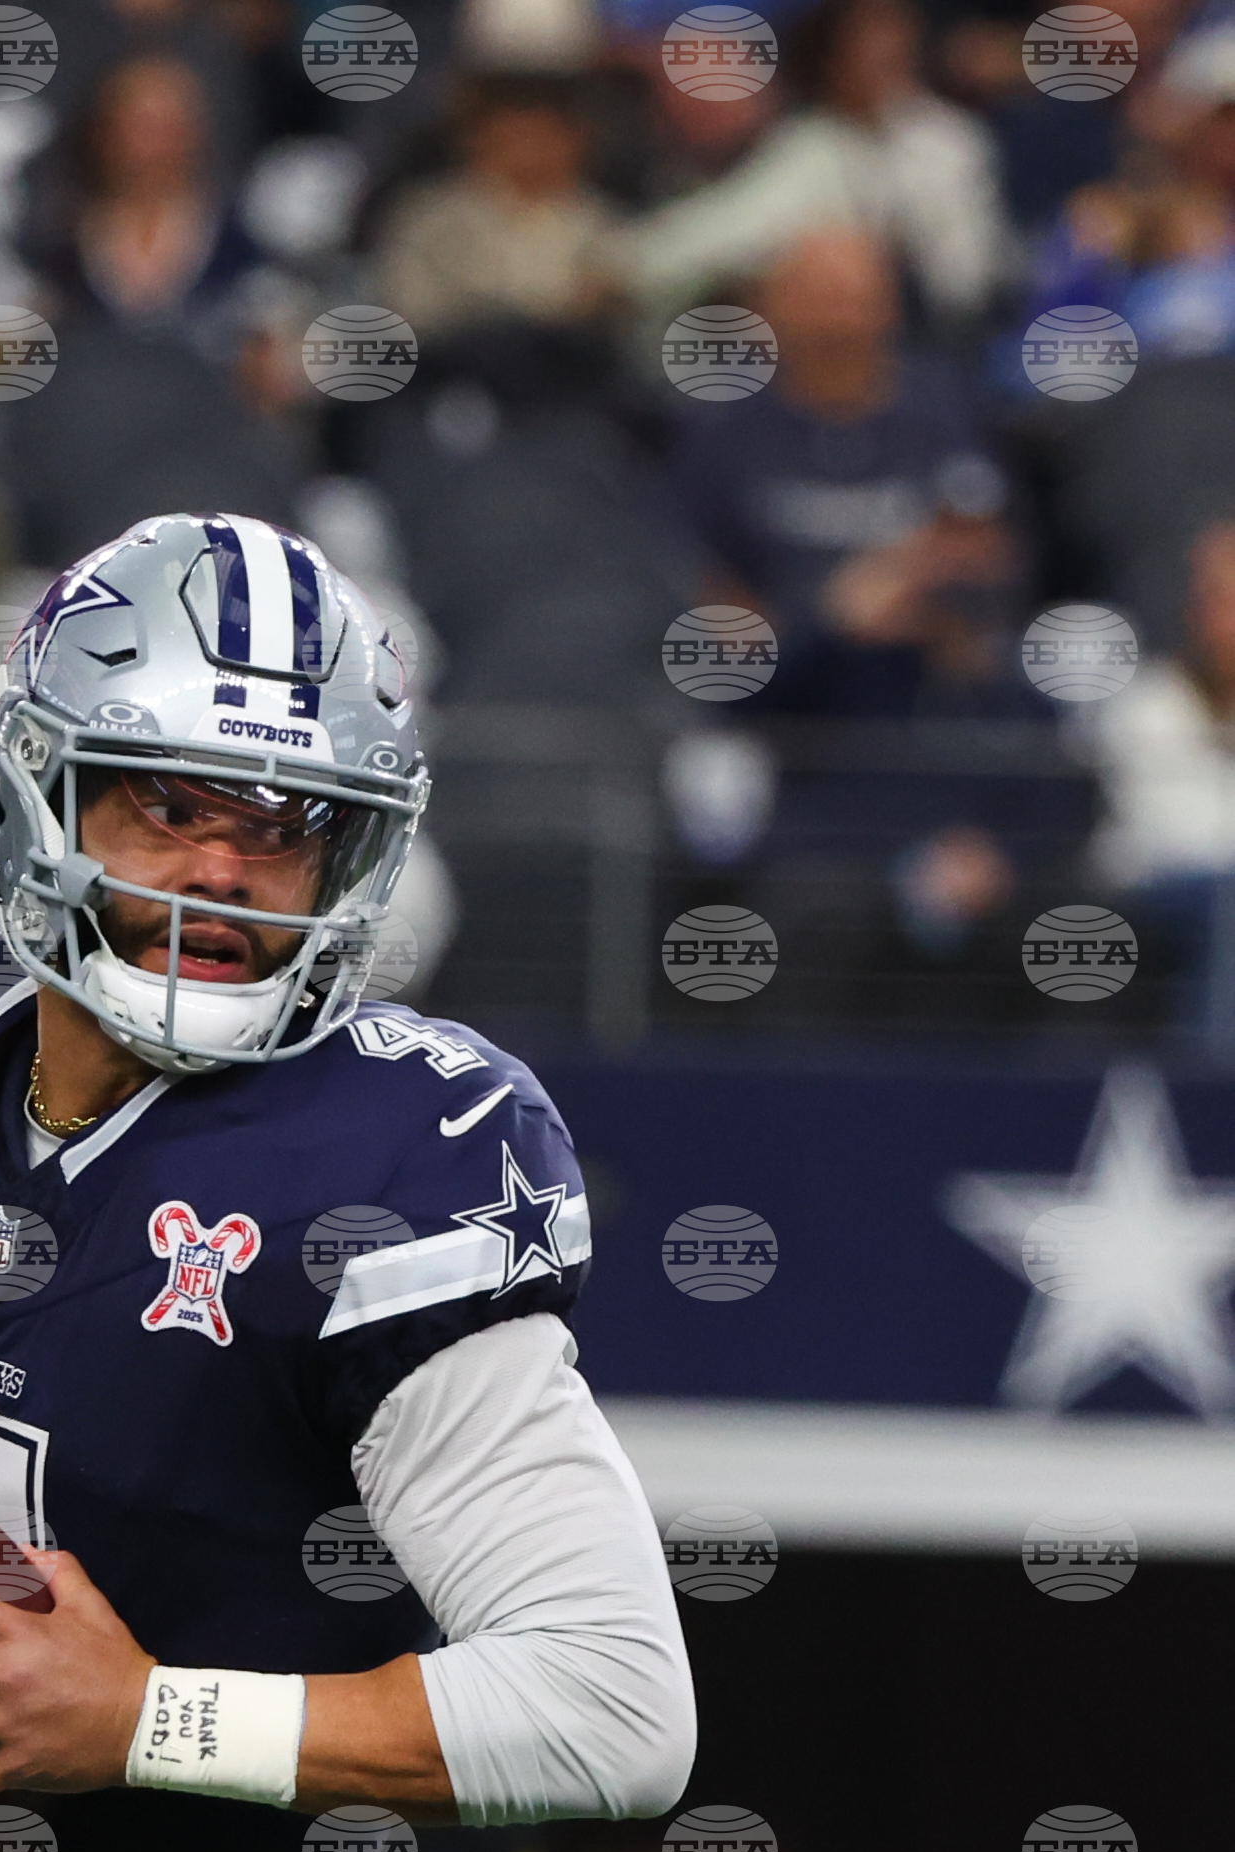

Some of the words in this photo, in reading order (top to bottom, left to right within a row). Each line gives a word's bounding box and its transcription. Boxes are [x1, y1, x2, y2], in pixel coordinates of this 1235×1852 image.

[218, 717, 313, 749] COWBOYS
[345, 1014, 490, 1080] 4
[176, 1264, 214, 1297] NFL
[176, 1308, 204, 1323] 2025
[144, 1683, 182, 1764] GOD!
[178, 1699, 194, 1739] YOU
[198, 1681, 220, 1760] THANK
